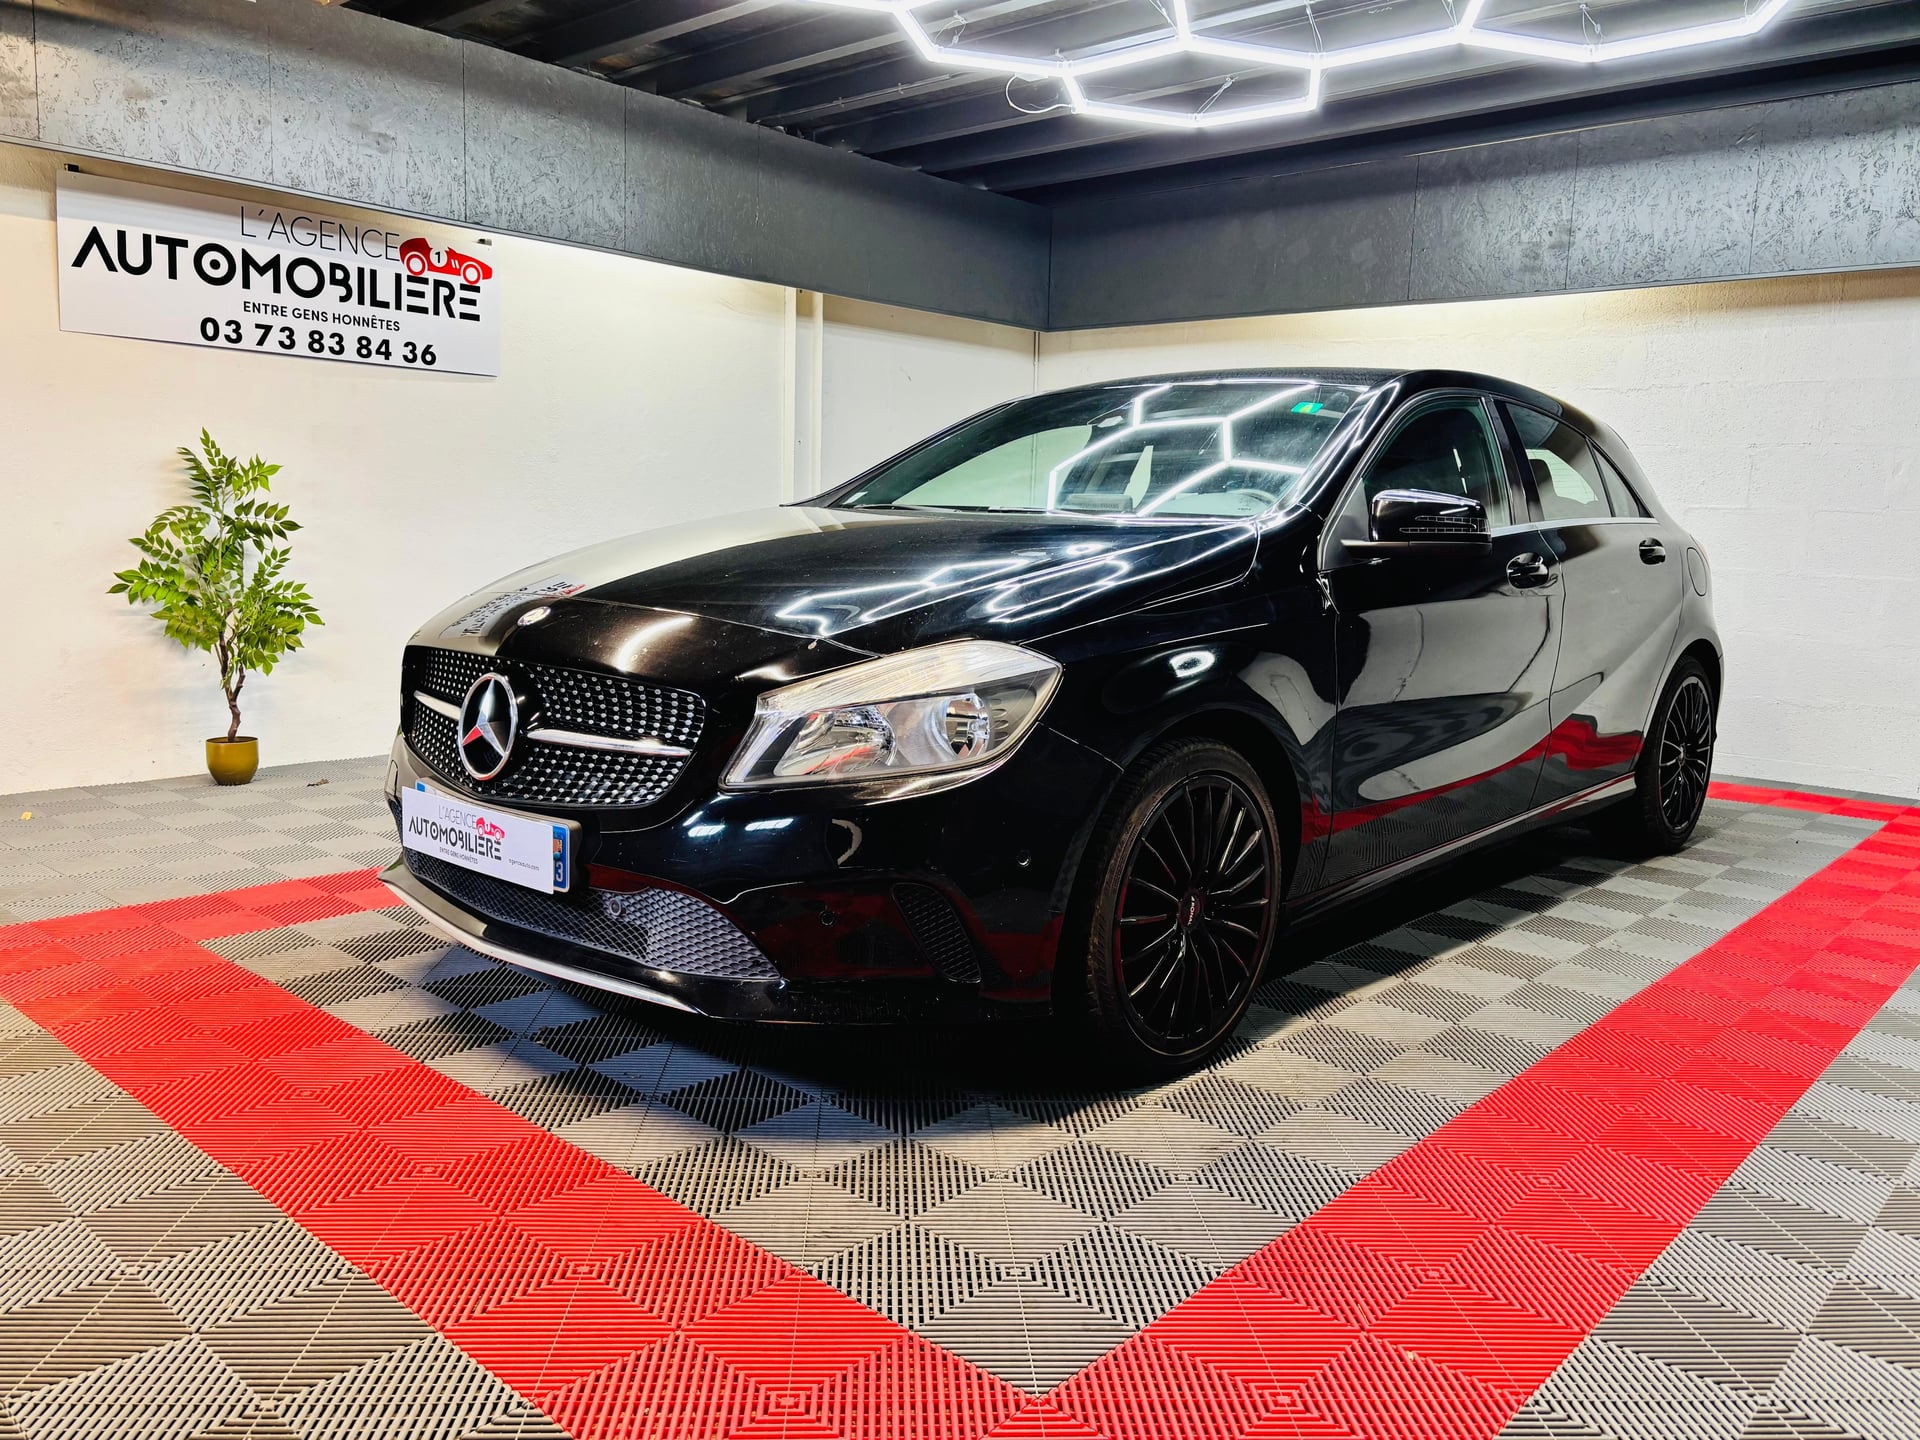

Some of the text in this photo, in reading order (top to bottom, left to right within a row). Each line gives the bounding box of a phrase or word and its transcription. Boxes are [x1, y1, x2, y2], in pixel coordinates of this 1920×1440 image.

[240, 204, 401, 263] L'AGENCE
[199, 316, 437, 366] 03 73 83 84 36
[243, 300, 401, 332] ENTRE GENS HONNÊTES
